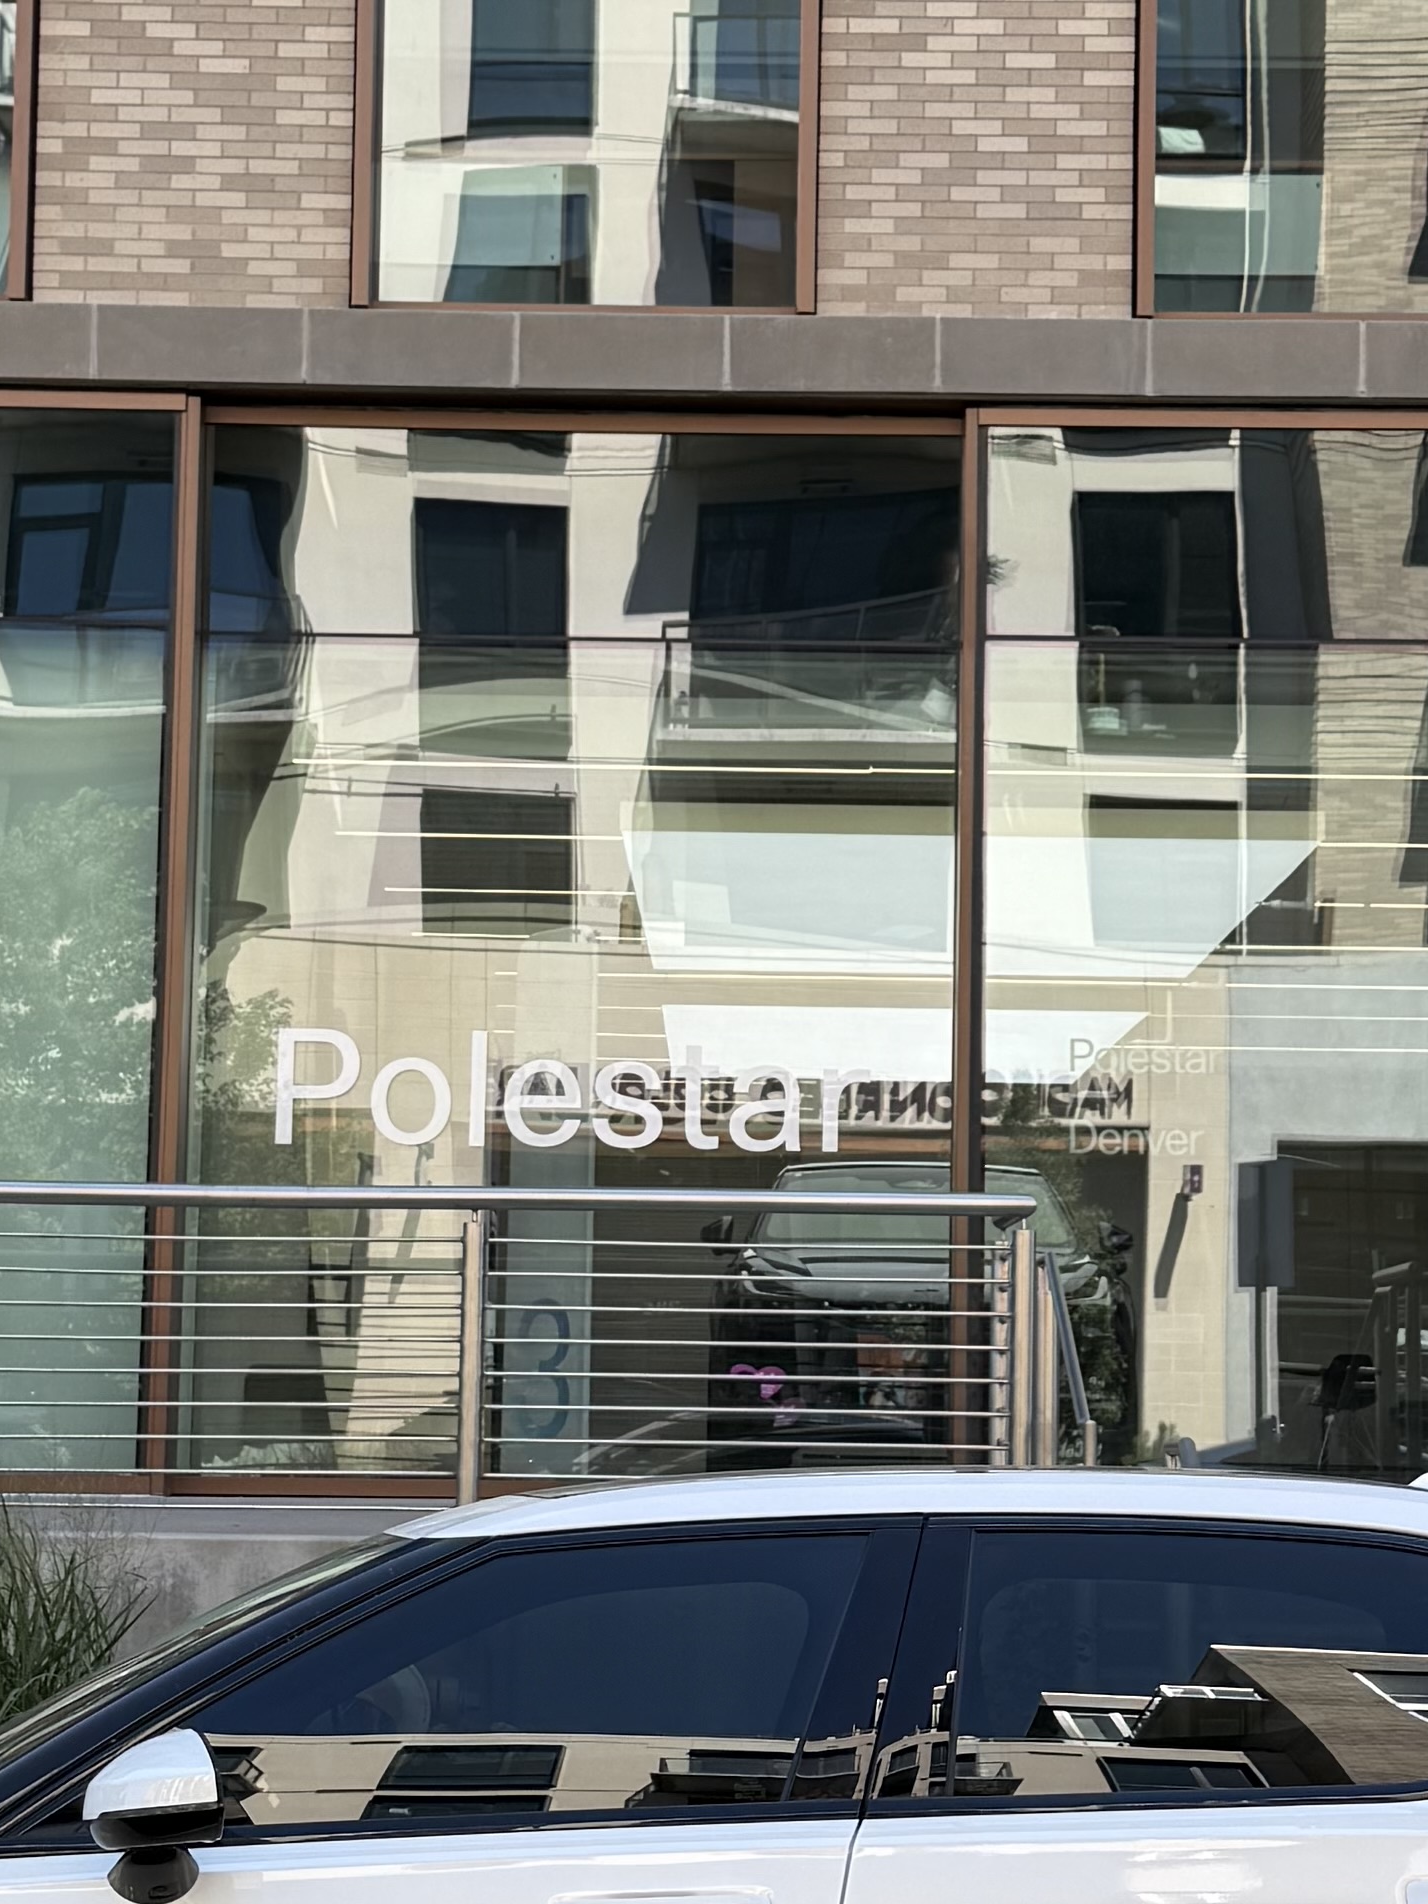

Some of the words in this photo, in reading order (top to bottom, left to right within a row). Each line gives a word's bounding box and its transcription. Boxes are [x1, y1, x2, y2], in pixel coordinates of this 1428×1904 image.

[1069, 1037, 1223, 1075] Polestar
[273, 1027, 872, 1154] Polestar
[1069, 1118, 1205, 1157] Denver
